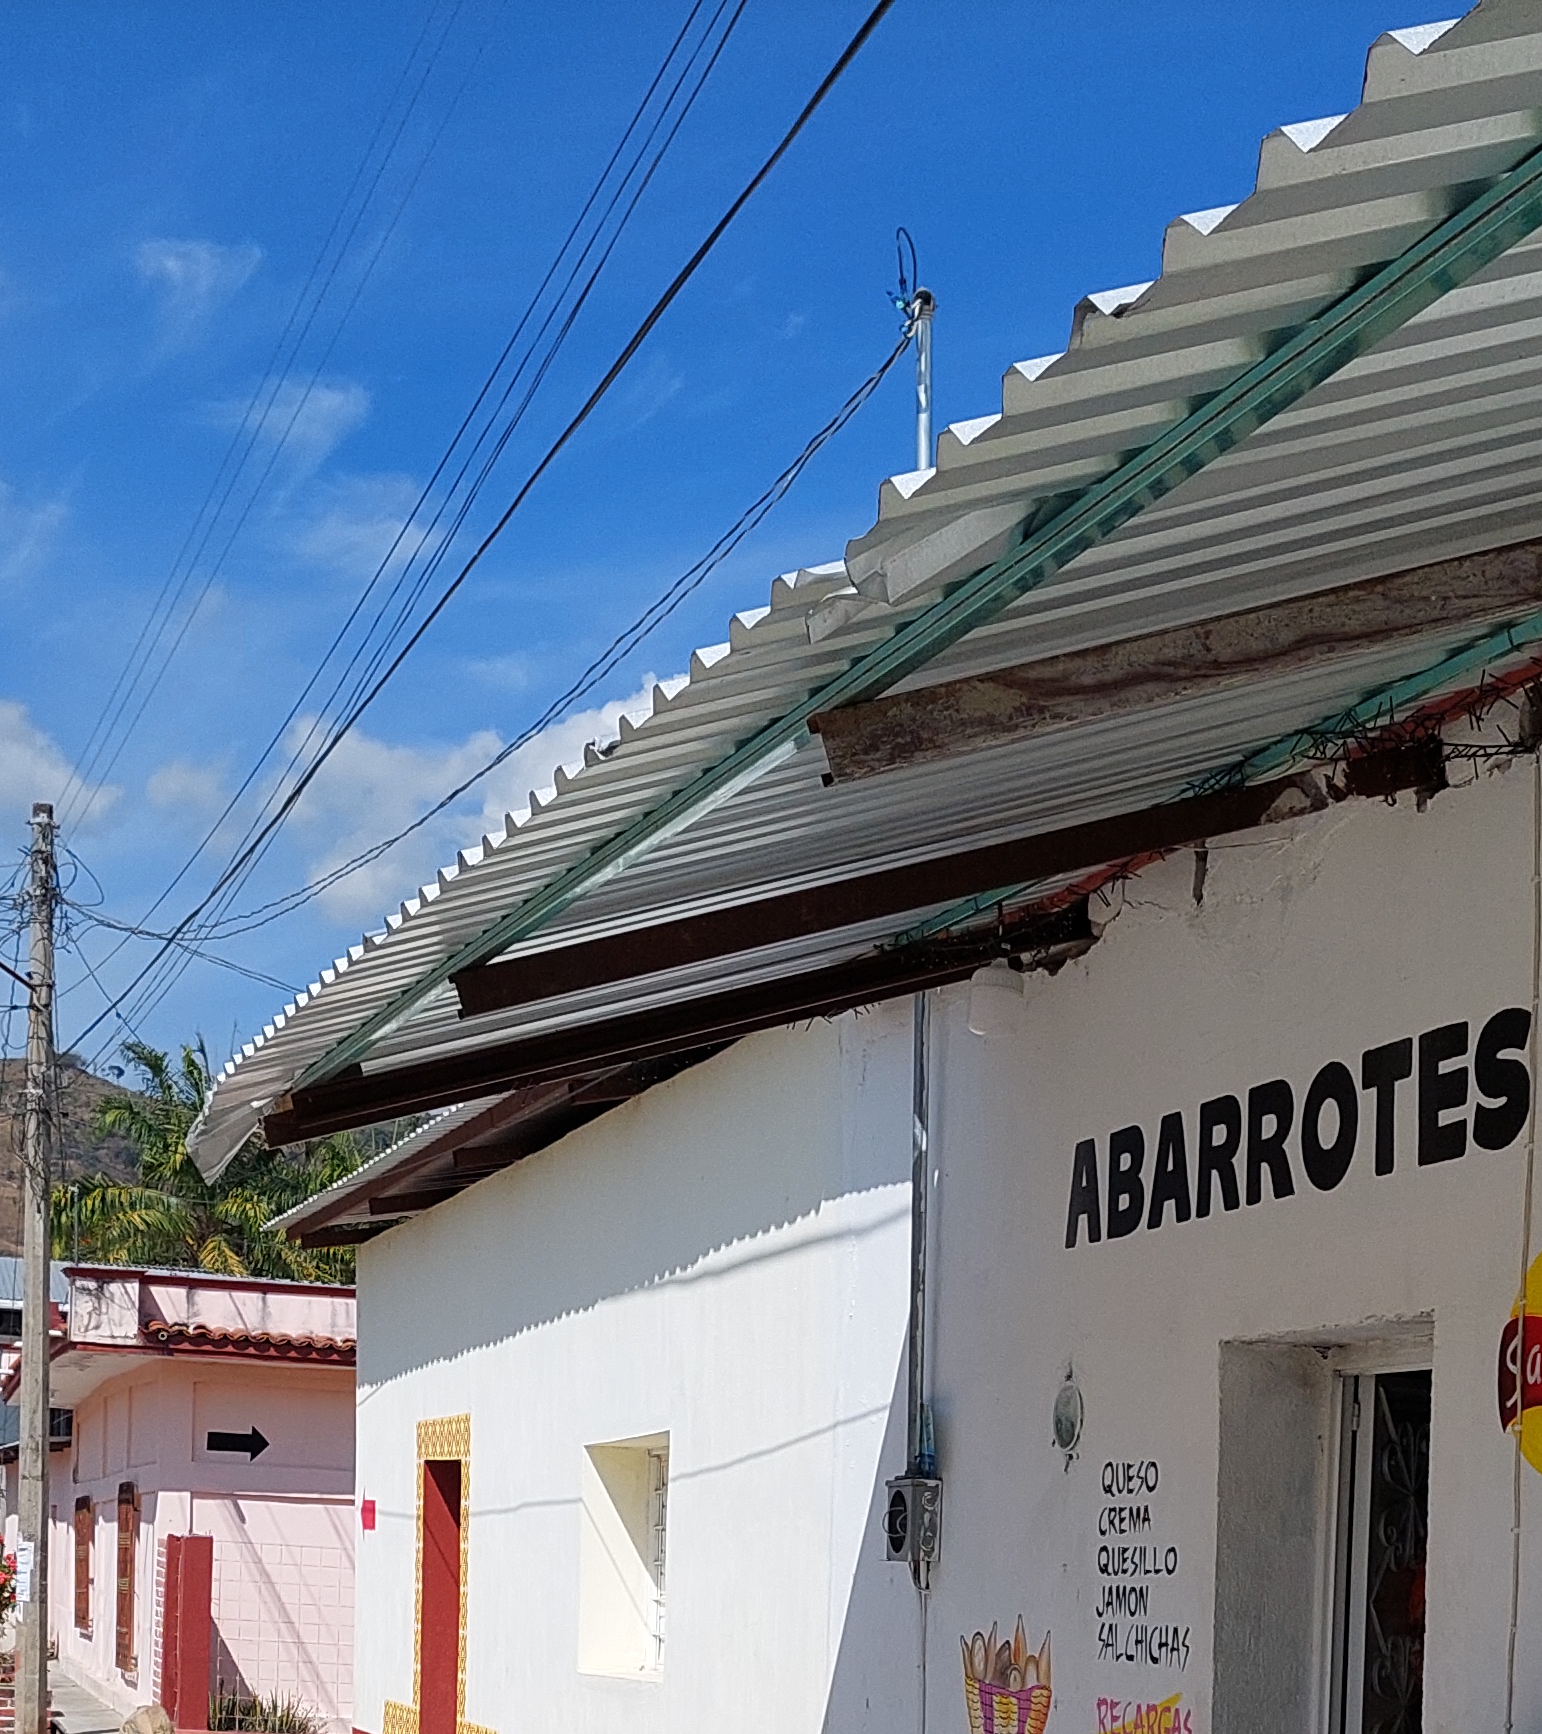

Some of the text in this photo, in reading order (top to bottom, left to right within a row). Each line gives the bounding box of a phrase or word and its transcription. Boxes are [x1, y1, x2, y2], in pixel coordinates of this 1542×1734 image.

[1064, 1007, 1532, 1248] ABARROTES
[1101, 1460, 1159, 1497] QUESO
[1098, 1504, 1152, 1537] CREMA
[1097, 1545, 1178, 1577] QUESILLO
[1095, 1584, 1149, 1618] JAMON
[1097, 1621, 1191, 1672] SALCHICHAS
